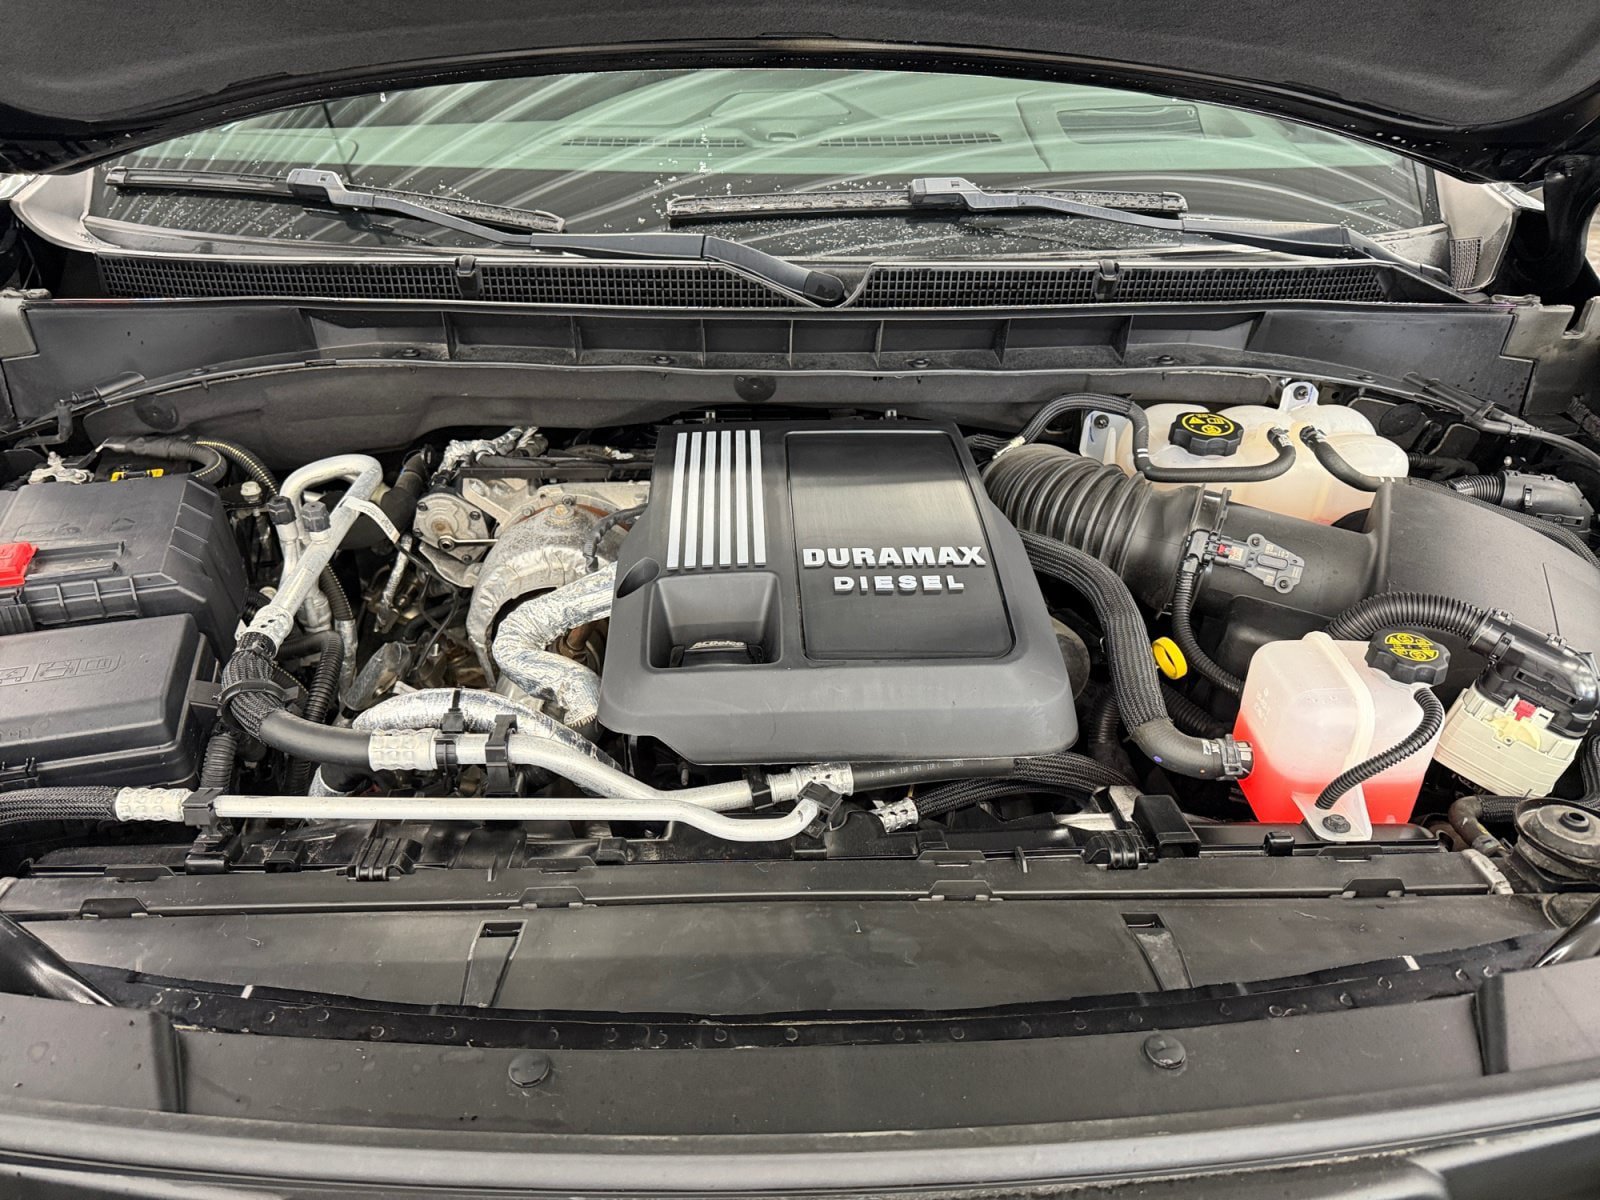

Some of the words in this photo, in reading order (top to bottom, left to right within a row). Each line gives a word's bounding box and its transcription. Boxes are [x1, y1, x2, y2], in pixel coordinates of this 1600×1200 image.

[802, 546, 987, 568] DURAMAX
[833, 575, 965, 593] DIESEL
[690, 640, 746, 650] ACDelco
